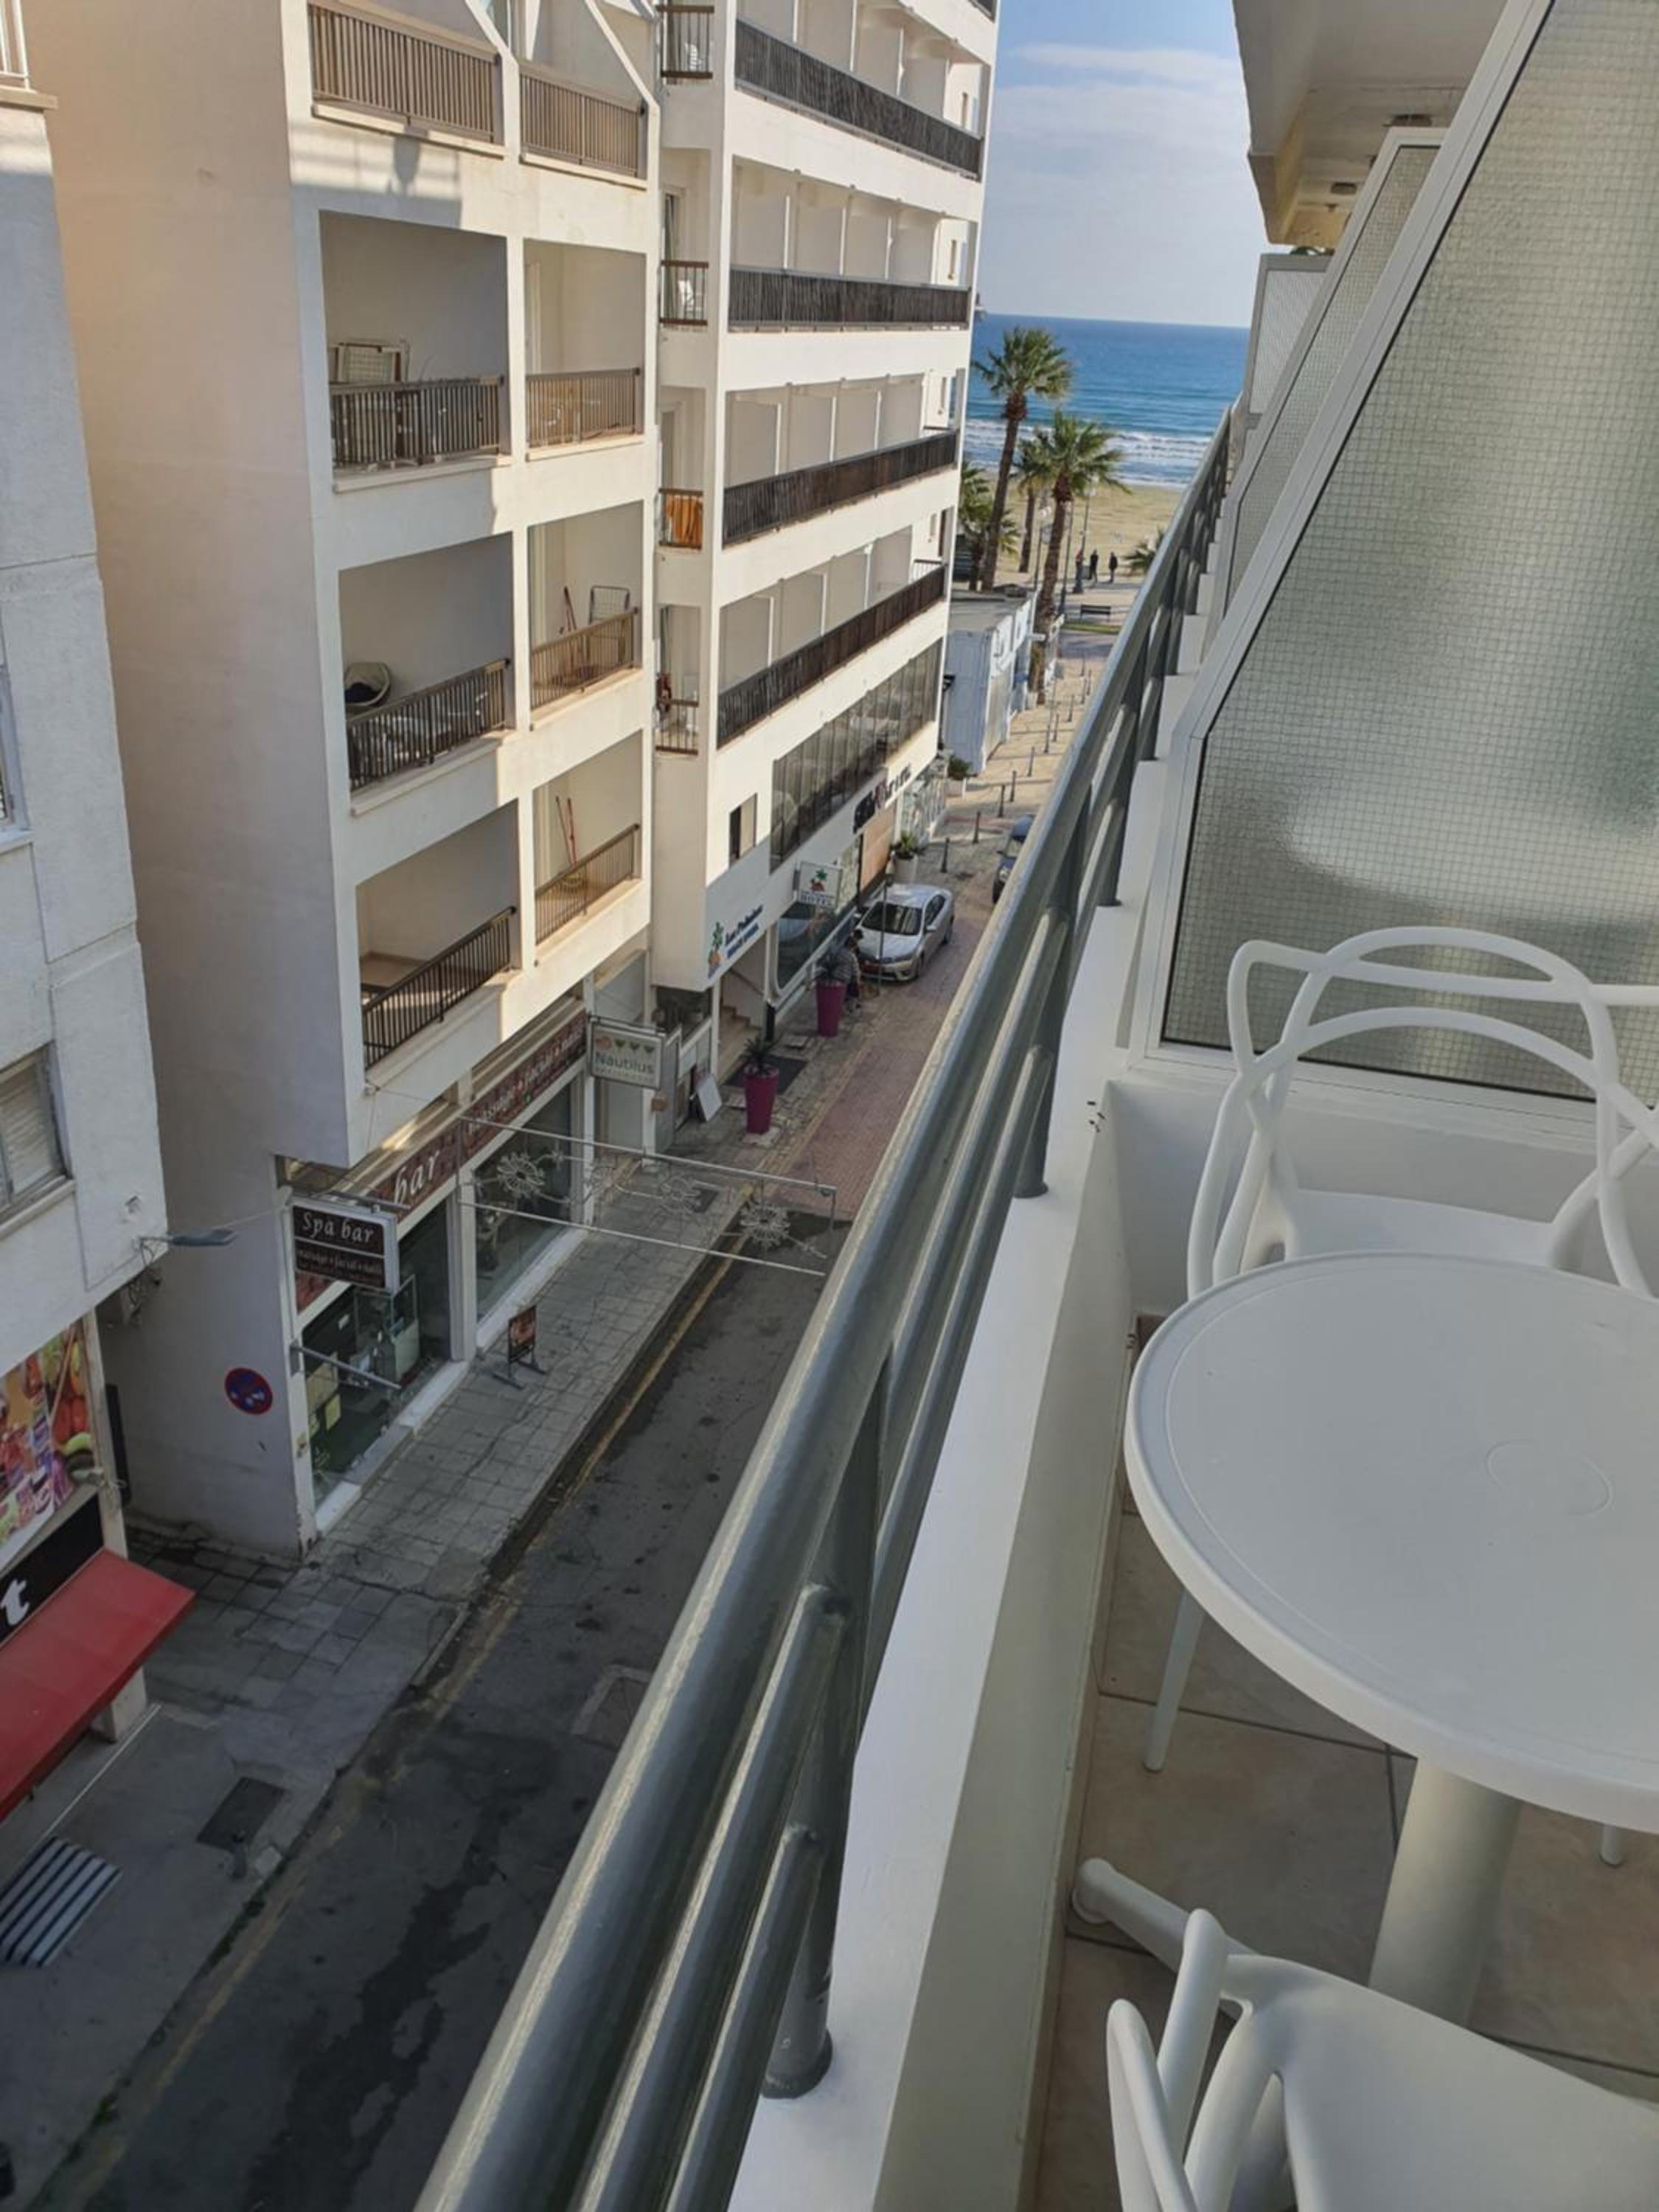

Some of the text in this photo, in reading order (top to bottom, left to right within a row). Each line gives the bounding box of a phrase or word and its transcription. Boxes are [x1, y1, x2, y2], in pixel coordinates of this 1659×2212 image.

[596, 1051, 655, 1075] Nautilus
[394, 1151, 439, 1203] bar
[302, 1212, 374, 1243] Spa bar
